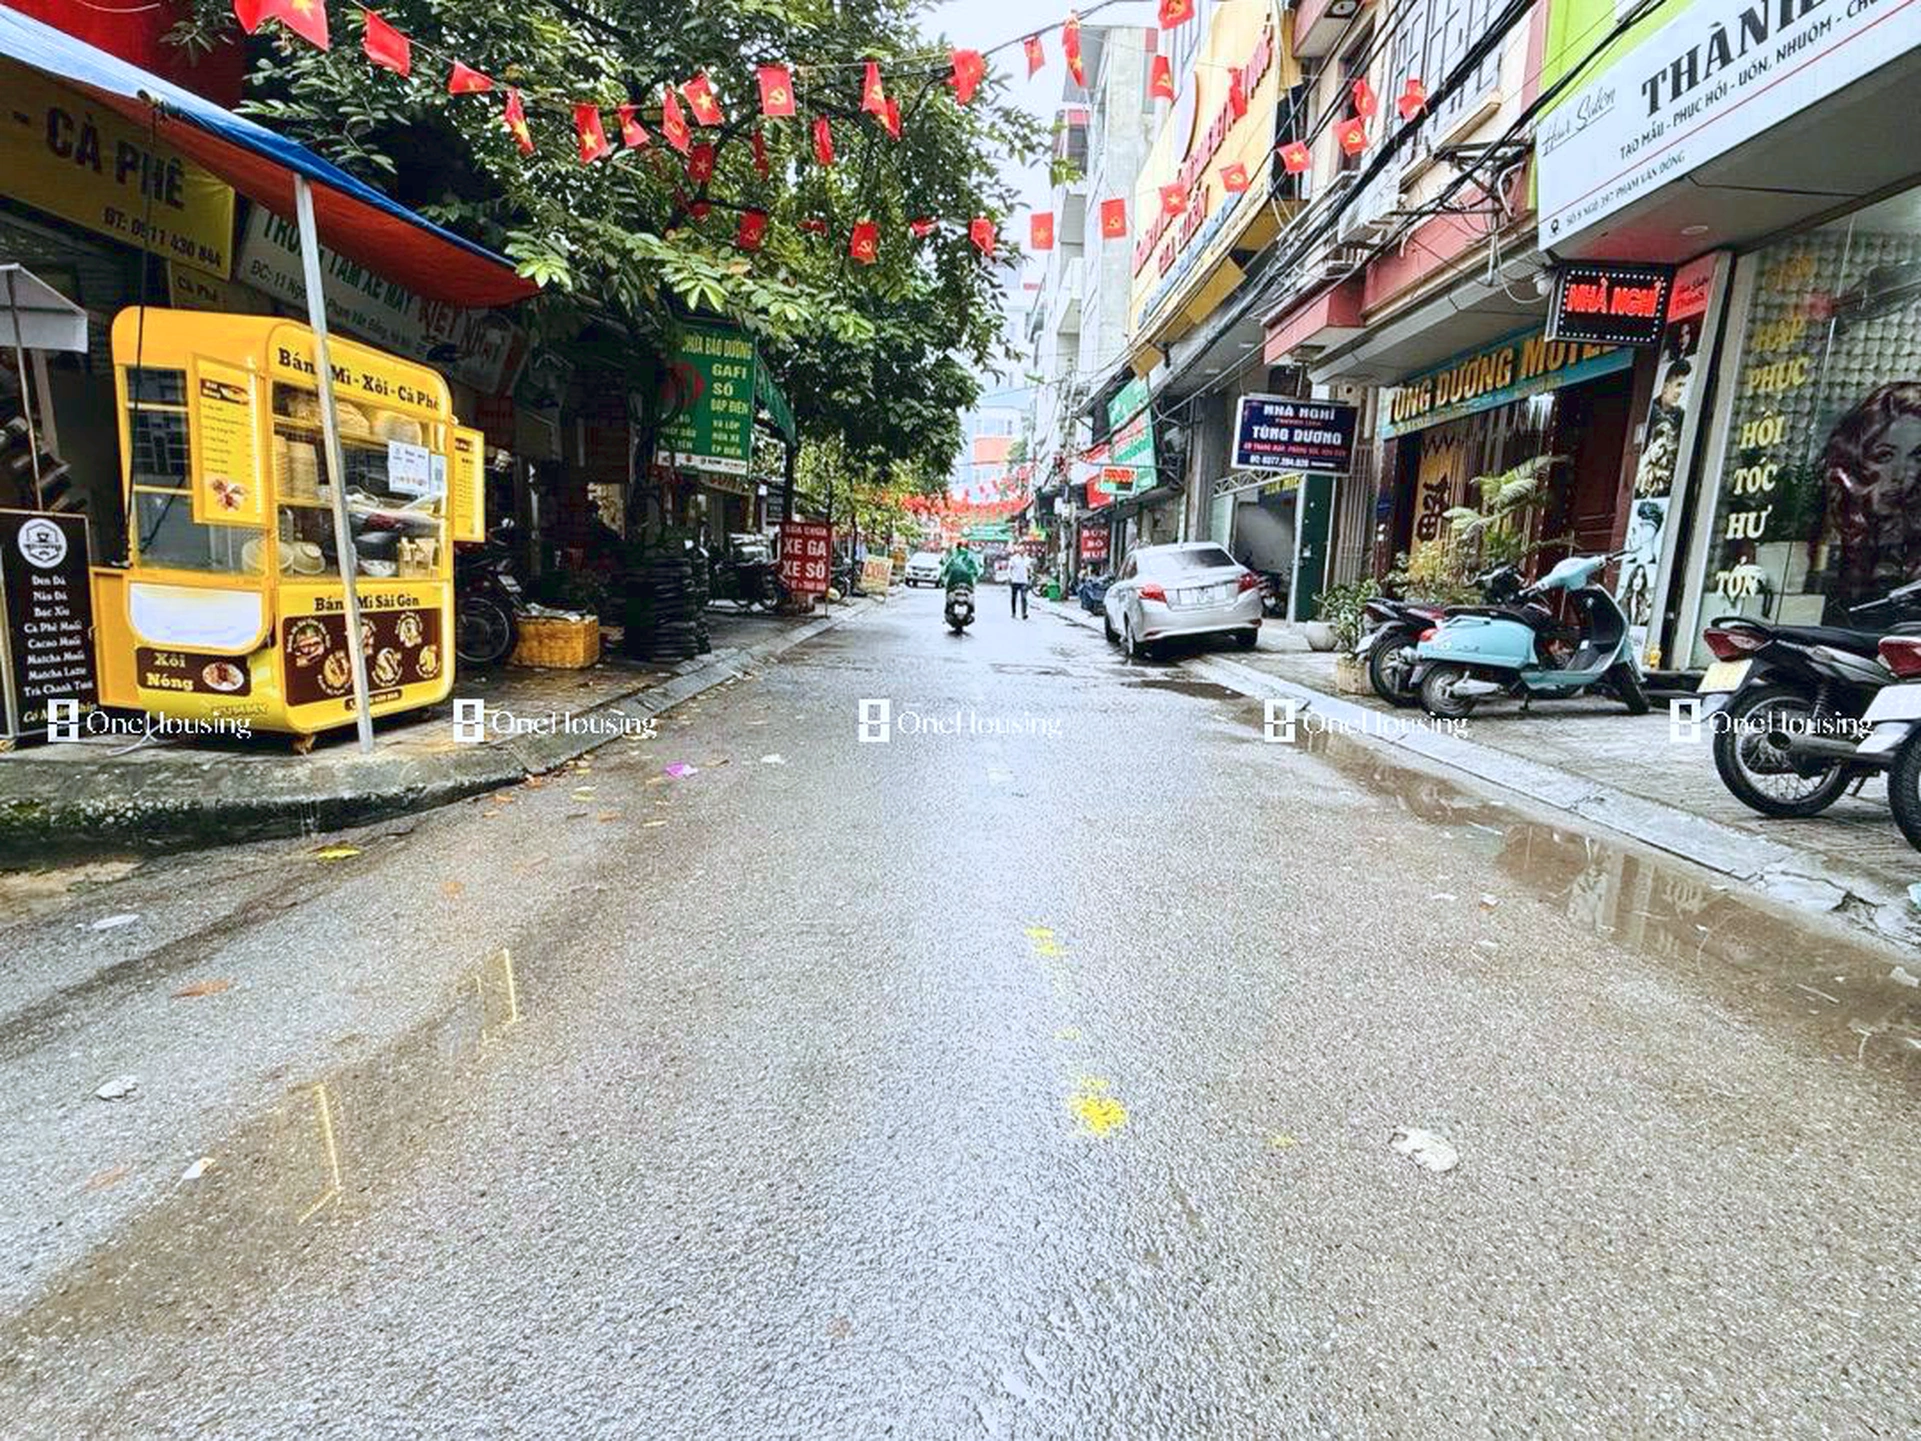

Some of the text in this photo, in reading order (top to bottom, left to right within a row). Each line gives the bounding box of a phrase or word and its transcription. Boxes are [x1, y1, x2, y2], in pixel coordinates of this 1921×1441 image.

[46, 107, 101, 172] CÀ
[115, 140, 184, 209] PHÊ
[263, 212, 326, 262] TRU
[1566, 277, 1608, 314] NHÀ
[1610, 280, 1662, 318] NGHỈ
[278, 347, 317, 375] Bán
[330, 363, 350, 385] Mì
[362, 374, 389, 396] Xôi
[398, 386, 414, 403] Cà
[1435, 350, 1514, 408] DƯƠNG
[1519, 335, 1619, 381] MOT
[1263, 404, 1335, 420] NHÀ NGHỈ
[1252, 424, 1342, 446] TÙNG DƯƠNG
[1738, 408, 1785, 450] HỒI
[1733, 457, 1778, 495] TÓC
[1725, 505, 1773, 540] HƯ
[783, 537, 827, 556] XE GA
[783, 558, 825, 579] XE SỐ
[314, 596, 344, 612] Bán
[376, 594, 395, 609] Sài
[397, 593, 420, 607] Gòn
[27, 653, 61, 665] Matcha
[153, 652, 186, 669] Xôi
[28, 668, 62, 680] Matcha
[146, 671, 194, 691] Nóng
